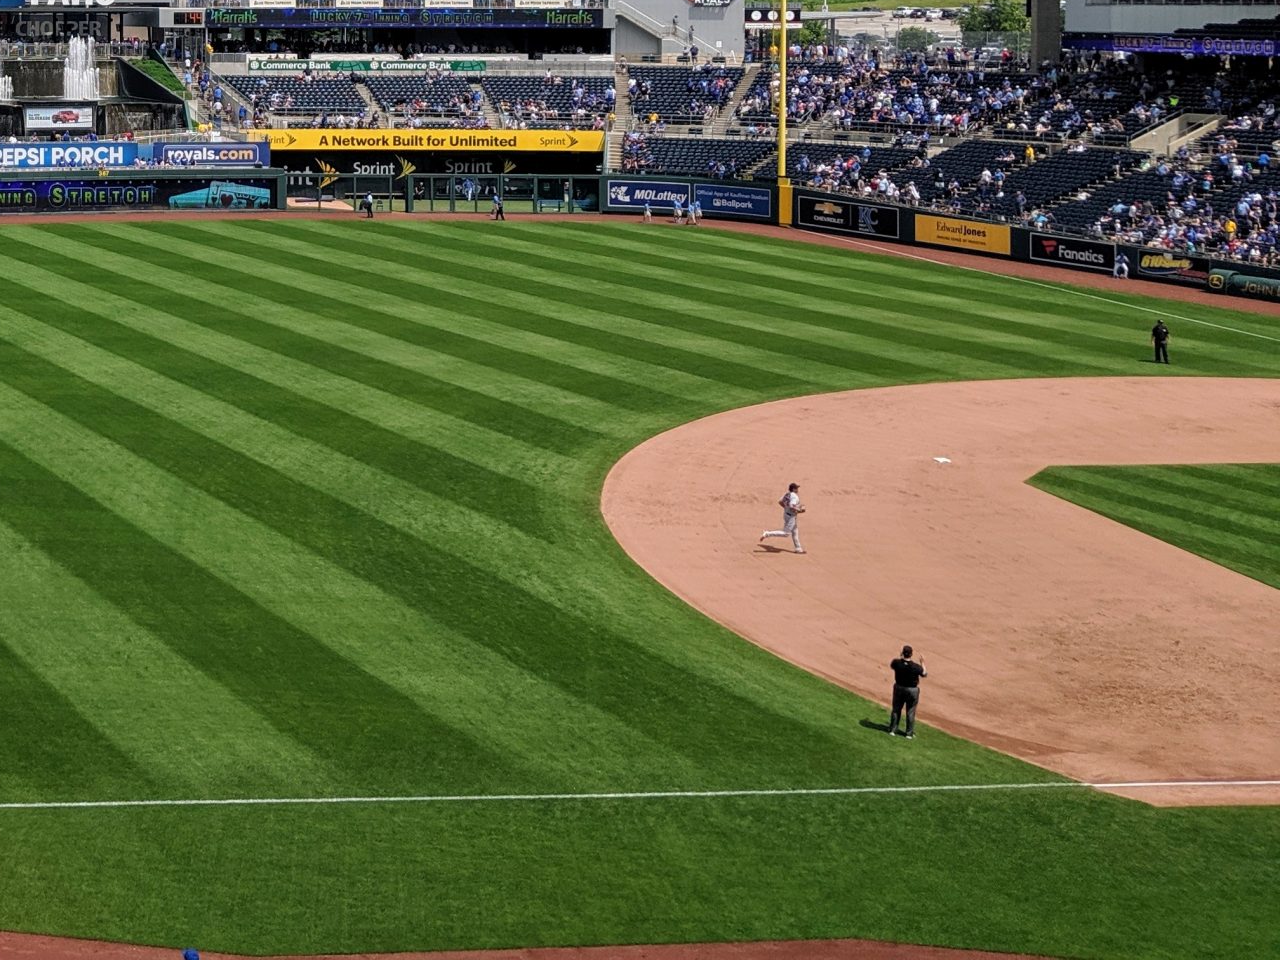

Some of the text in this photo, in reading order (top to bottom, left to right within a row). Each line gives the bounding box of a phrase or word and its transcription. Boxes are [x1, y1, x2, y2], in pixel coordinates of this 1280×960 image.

[312, 10, 350, 23] LUCKY
[375, 11, 408, 23] INNING
[422, 12, 493, 23] STRETCH
[1204, 38, 1274, 53] STRETCH
[261, 61, 452, 70] Commerce Bank Commerce Bank
[319, 136, 329, 146] A
[332, 135, 390, 146] Network
[393, 135, 423, 147] Built
[427, 136, 446, 147] for
[450, 136, 516, 147] Unlimited
[540, 137, 566, 147] Sprint
[51, 146, 123, 165] PORCH
[167, 147, 253, 165] royals.com
[353, 162, 395, 175] Sprint
[445, 159, 493, 174] Sprint
[52, 187, 150, 203] STRETCH
[634, 189, 687, 203] MOLottery
[722, 199, 752, 208] Ballpark
[814, 215, 844, 224] CHEVROLET
[937, 221, 986, 237] Edward Jones
[1059, 246, 1104, 263] Fanatics
[1242, 281, 1273, 296] JOHN
